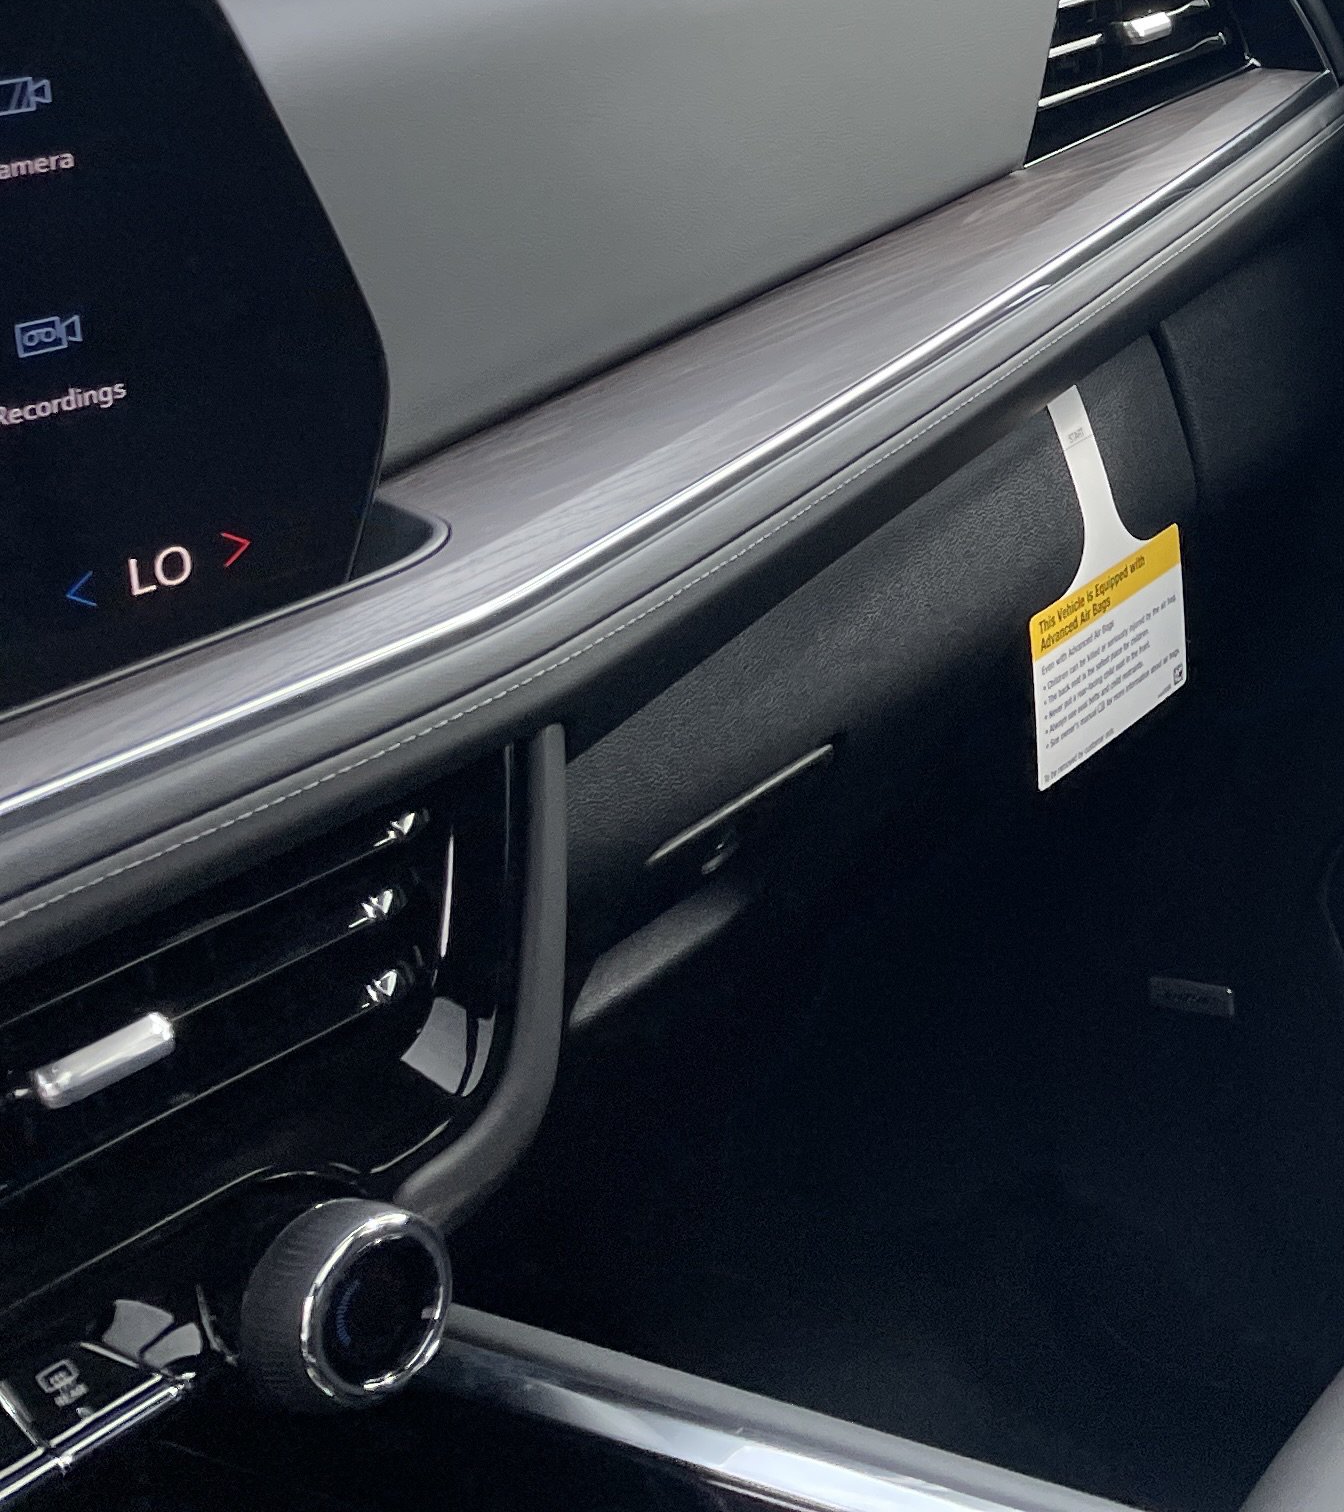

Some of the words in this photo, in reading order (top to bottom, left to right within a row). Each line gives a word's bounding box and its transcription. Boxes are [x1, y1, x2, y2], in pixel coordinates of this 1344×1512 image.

[0, 153, 74, 180] amera
[0, 383, 127, 425] Recordings
[128, 545, 192, 596] LO
[1038, 615, 1056, 635] This
[1057, 597, 1085, 623] Vehicle
[1095, 566, 1128, 597] Equipped
[1129, 555, 1145, 574] with
[1040, 620, 1078, 652] Advanced
[1079, 609, 1091, 625] Air
[1092, 597, 1111, 616] Bags
